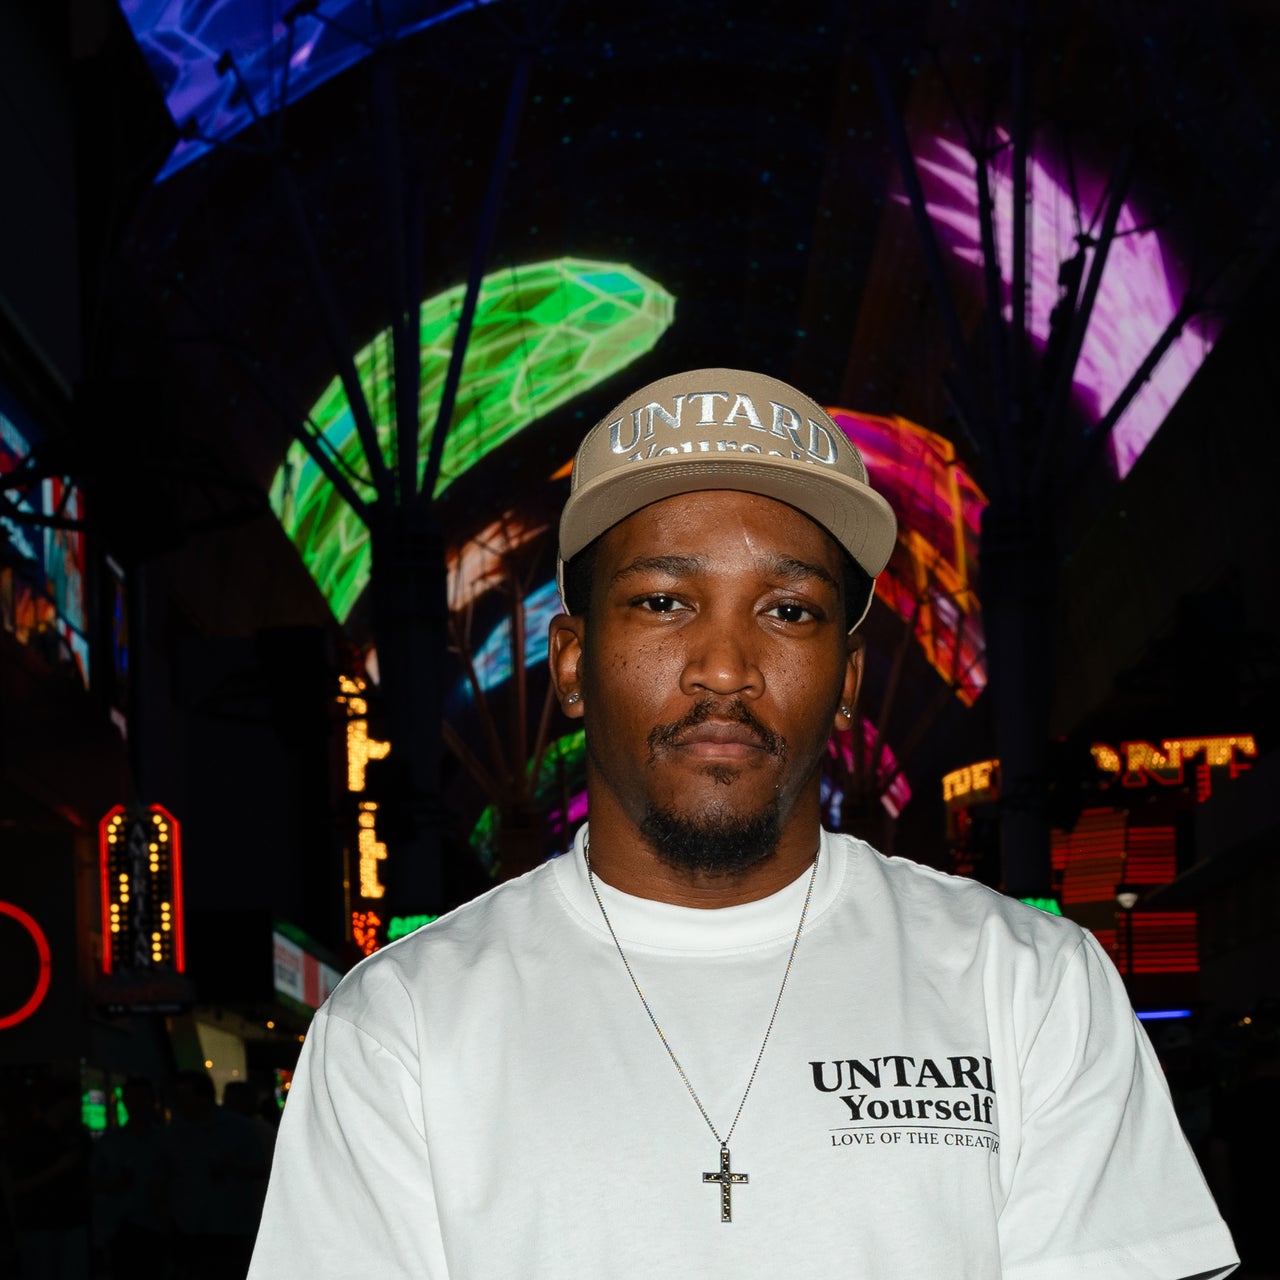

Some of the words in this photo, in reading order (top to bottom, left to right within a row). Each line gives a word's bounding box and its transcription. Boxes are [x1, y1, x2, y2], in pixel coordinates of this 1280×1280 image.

[608, 391, 839, 465] UNTARD
[839, 1093, 994, 1125] Yourself
[831, 1132, 876, 1147] LOVE
[880, 1132, 902, 1144] OF
[906, 1131, 940, 1145] THE
[944, 1133, 1000, 1155] CREATR
